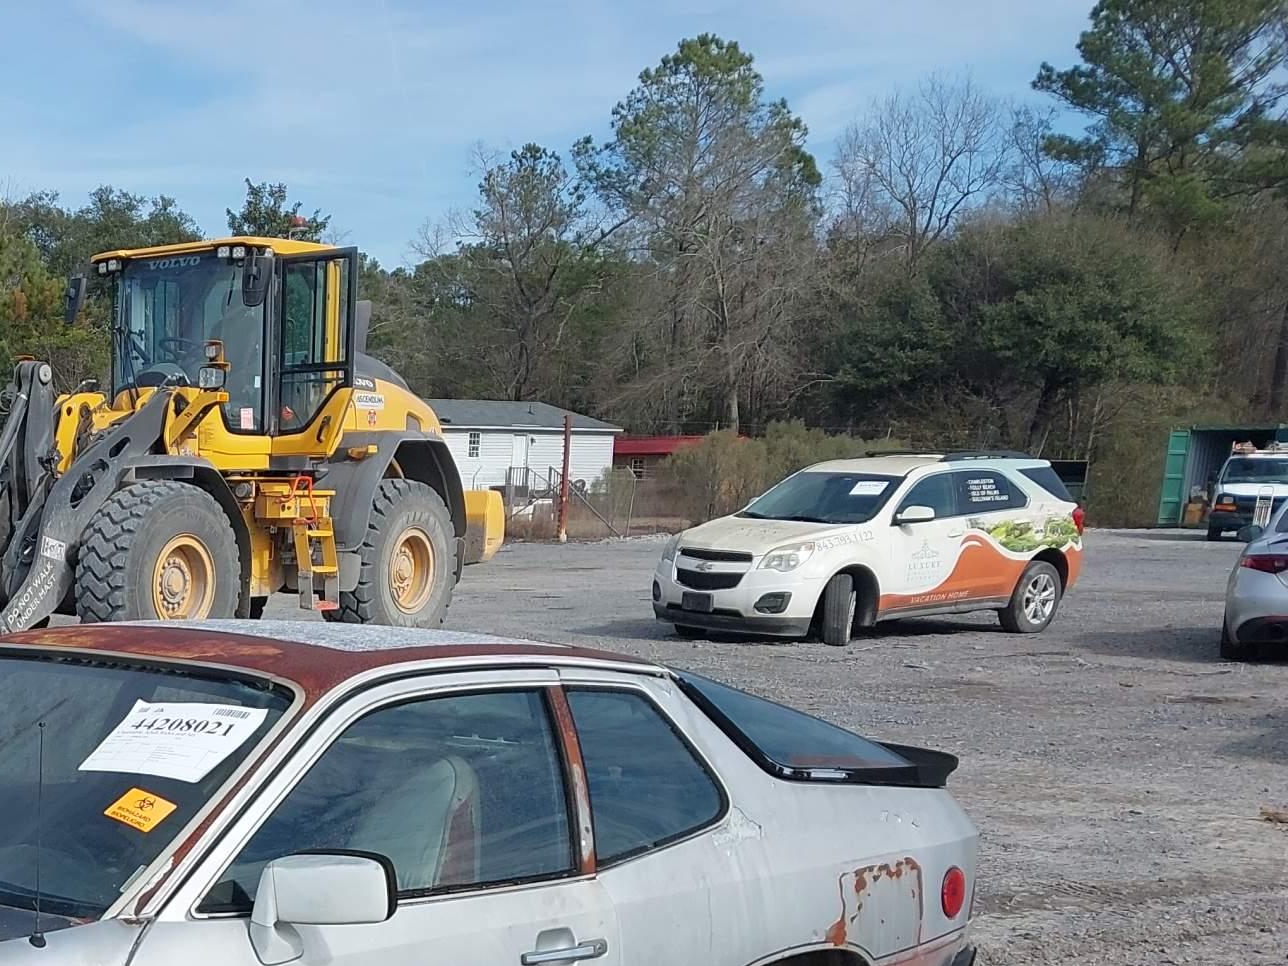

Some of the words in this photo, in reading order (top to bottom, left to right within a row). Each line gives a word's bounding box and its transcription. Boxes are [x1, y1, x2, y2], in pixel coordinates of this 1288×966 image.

[147, 256, 200, 270] VOLVO
[7, 608, 19, 625] DO
[18, 586, 33, 609] NOT
[33, 561, 54, 588] WALK
[16, 597, 40, 628] UNDER
[38, 573, 57, 600] MAST
[132, 717, 236, 737] 44208021
[117, 806, 151, 822] BIOHAZARD
